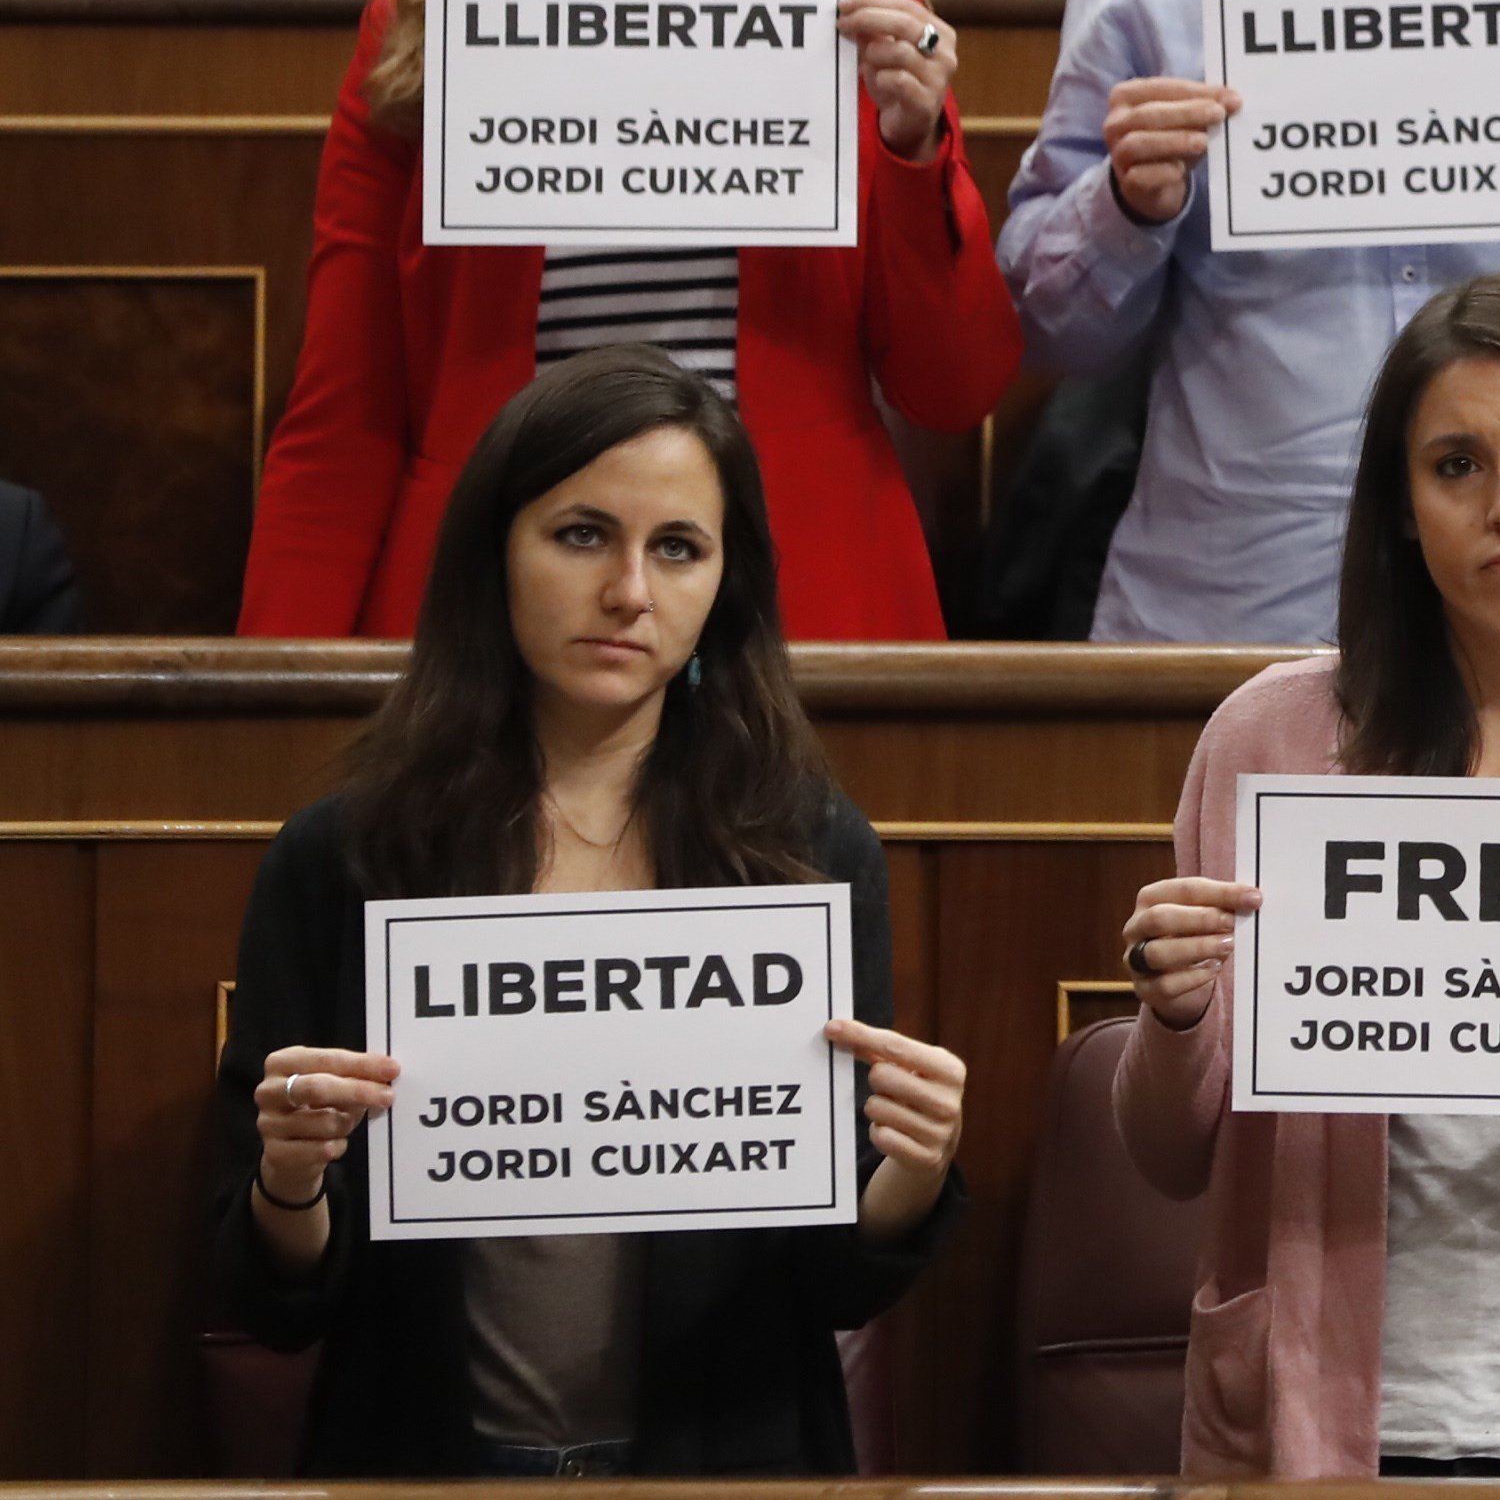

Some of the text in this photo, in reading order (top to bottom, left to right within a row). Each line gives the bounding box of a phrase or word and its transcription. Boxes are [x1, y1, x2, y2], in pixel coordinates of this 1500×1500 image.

[465, 3, 817, 48] LLIBERTAT
[469, 110, 810, 146] JORDI SÀNCHEZ
[1253, 120, 1377, 151] JORDI
[476, 166, 803, 194] JORDI CUIXART
[1261, 169, 1385, 199] JORDI
[414, 953, 803, 1018] LIBERTAD
[1284, 965, 1423, 997] JORDI
[1290, 1020, 1429, 1052] JORDI
[419, 1080, 802, 1128] JORDI SÀNCHEZ
[427, 1139, 795, 1182] JORDI CUIXART
